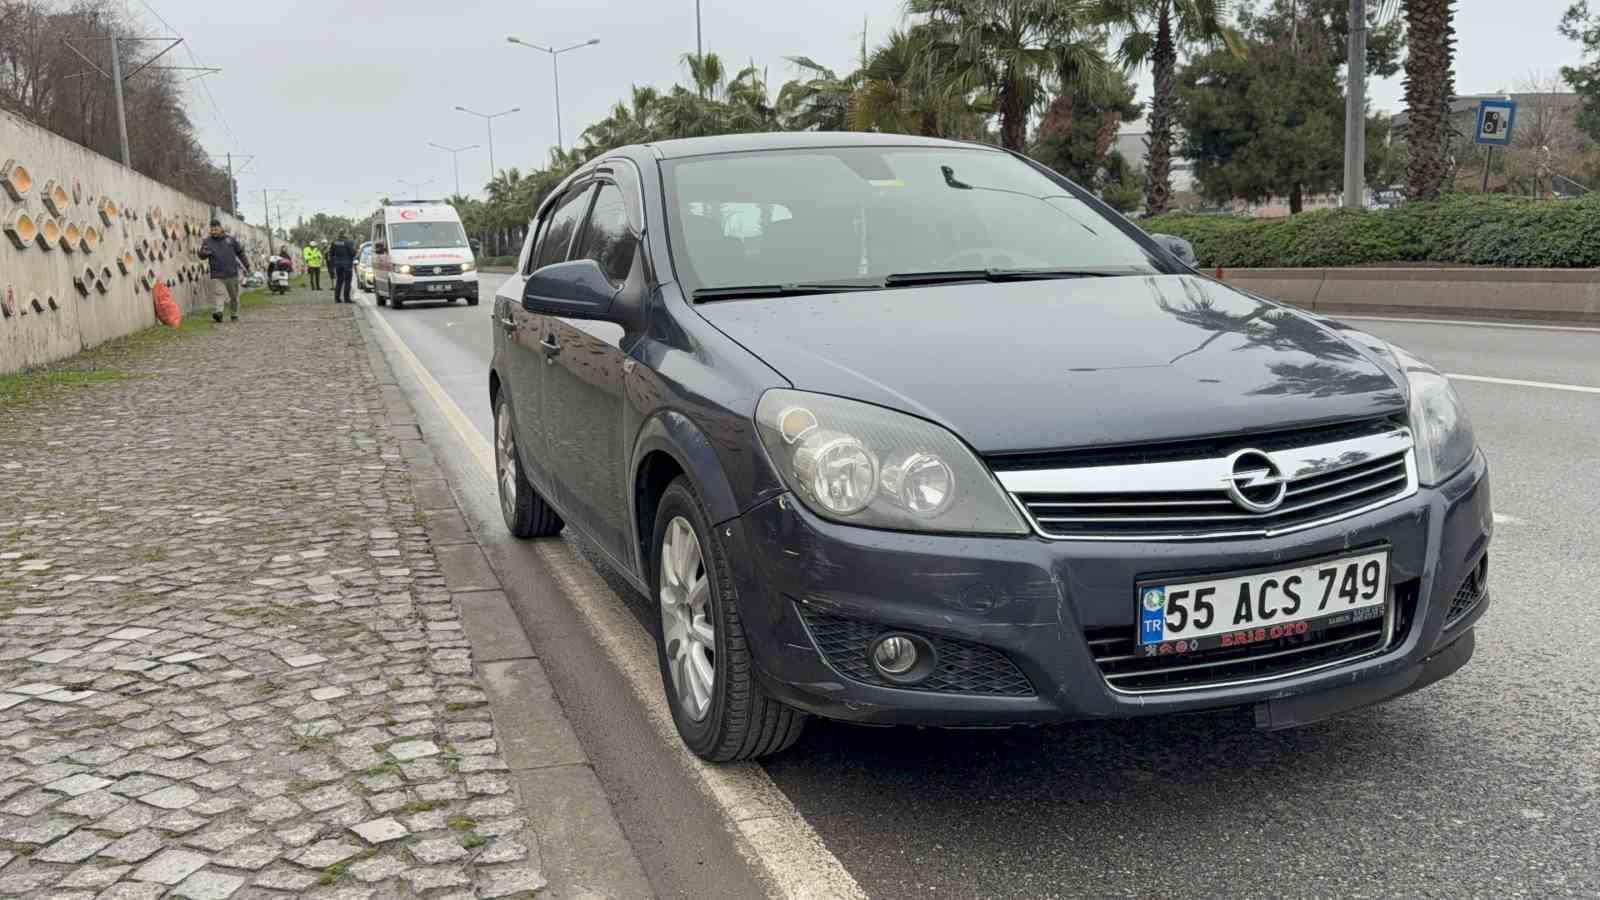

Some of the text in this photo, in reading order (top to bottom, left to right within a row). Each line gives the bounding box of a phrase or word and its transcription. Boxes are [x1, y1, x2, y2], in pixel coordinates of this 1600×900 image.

[1166, 560, 1380, 633] 55 ACS 749
[1144, 619, 1161, 632] TR
[1271, 622, 1308, 639] OTO
